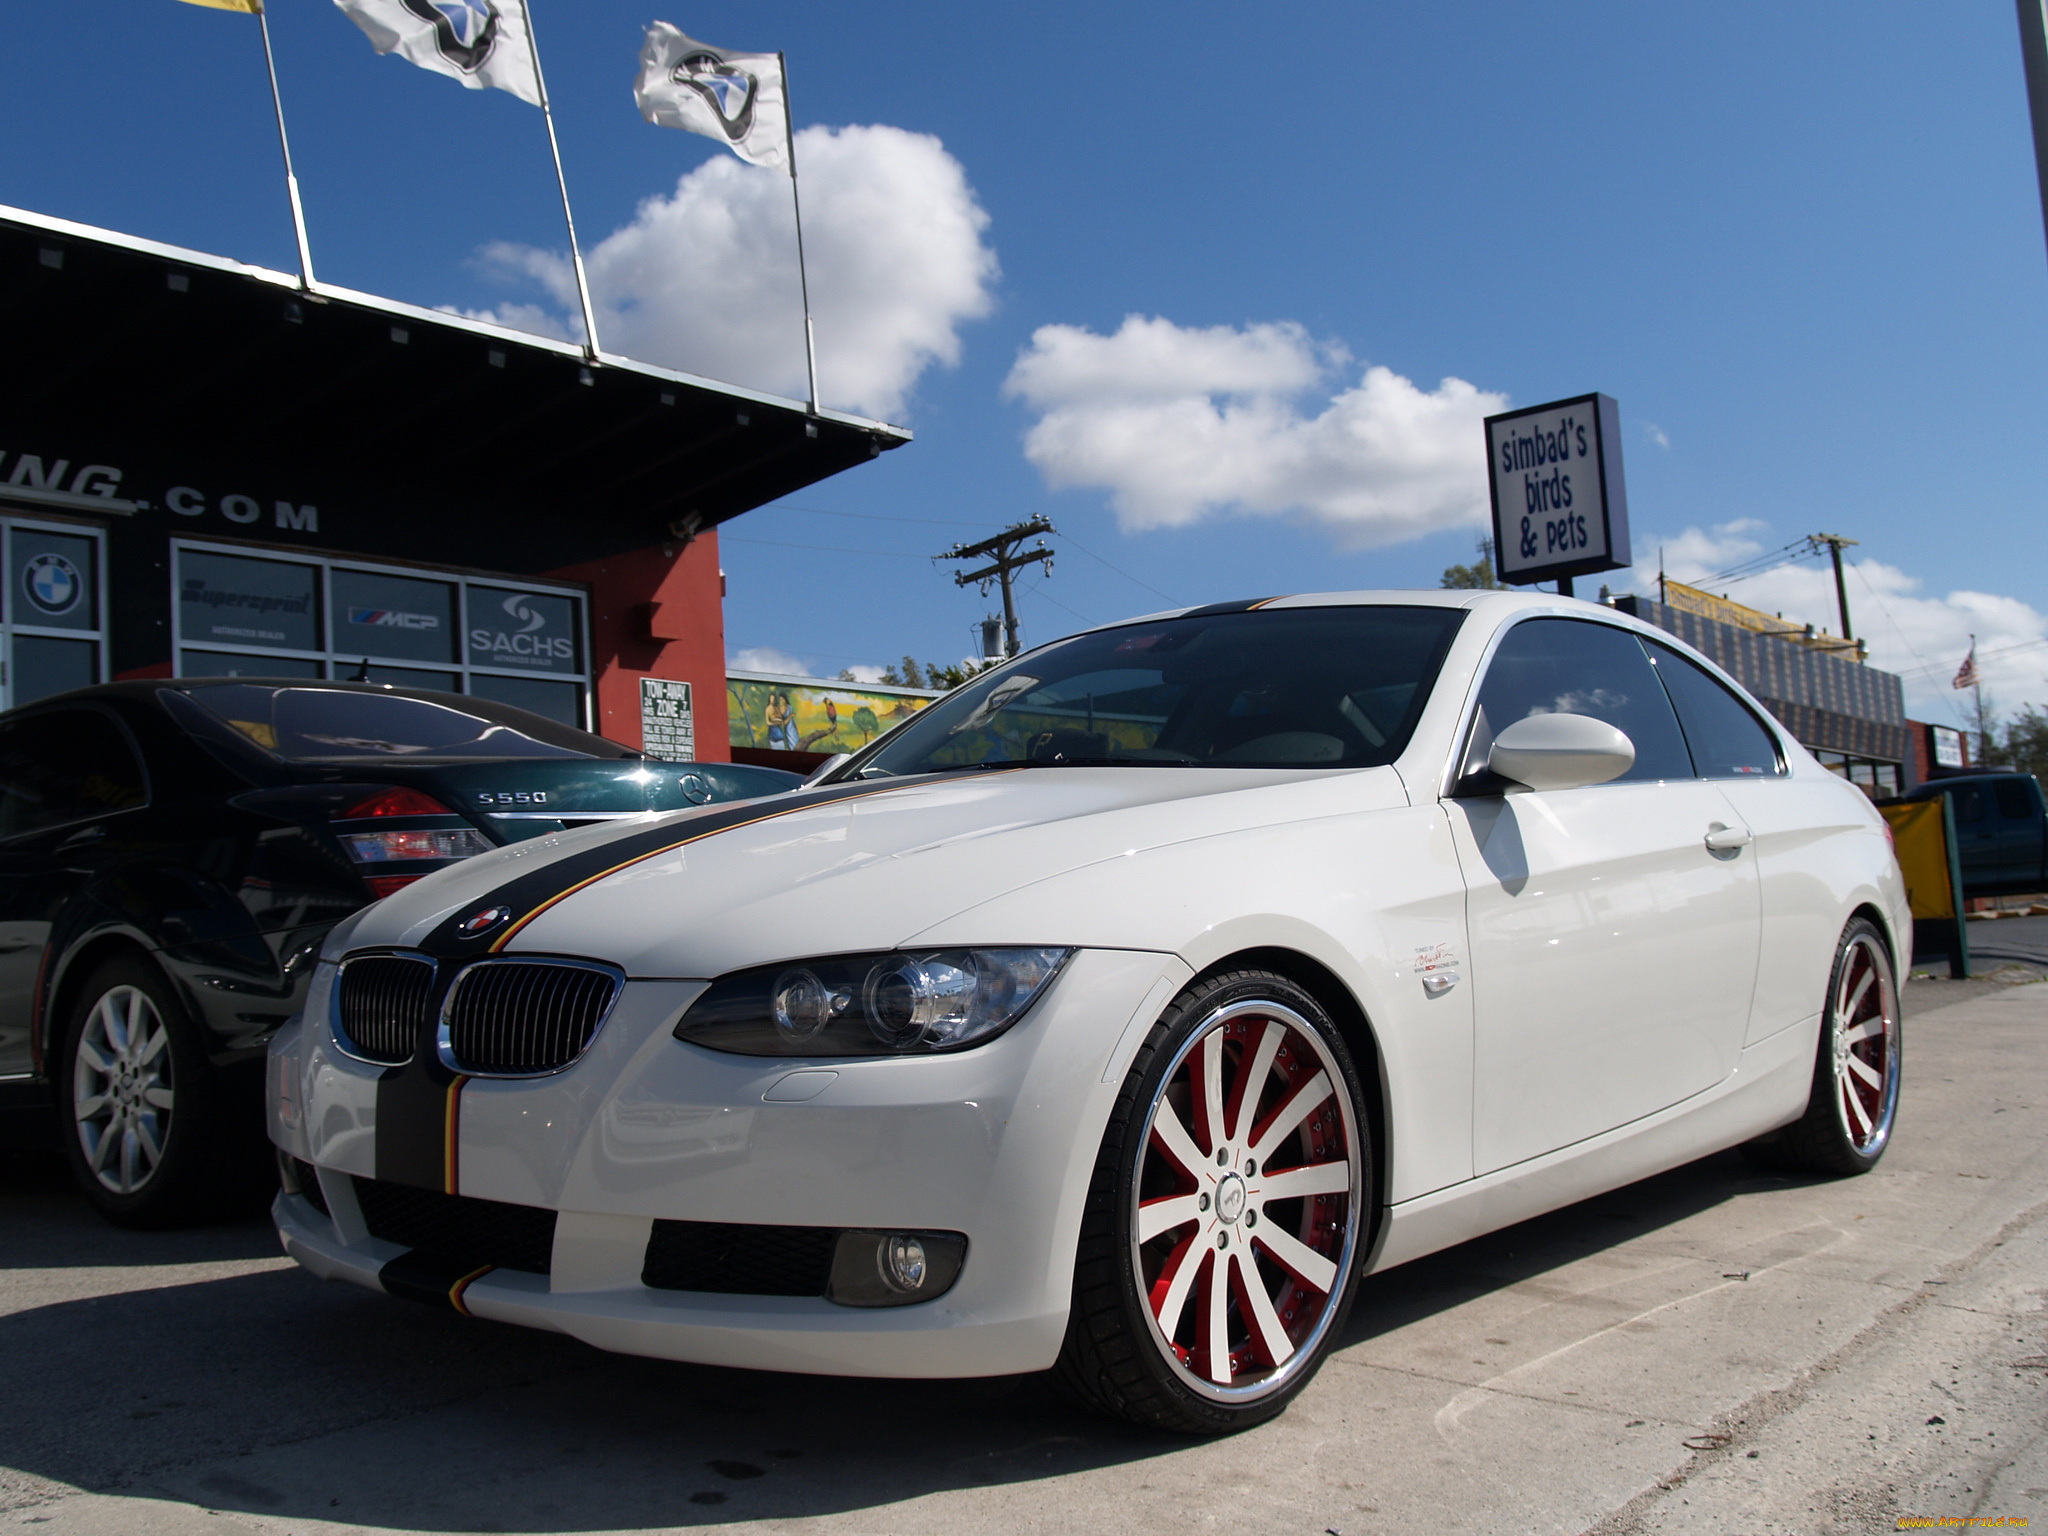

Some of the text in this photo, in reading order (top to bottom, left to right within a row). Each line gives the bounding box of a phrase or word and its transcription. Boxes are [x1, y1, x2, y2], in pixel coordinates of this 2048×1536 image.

[1503, 416, 1587, 472] simbad's
[1525, 467, 1572, 514] birds
[1520, 510, 1588, 559] & pets
[470, 629, 573, 658] SACHS
[645, 681, 687, 700] TOW-AWAY
[656, 699, 679, 717] ZONE
[682, 701, 688, 710] 7
